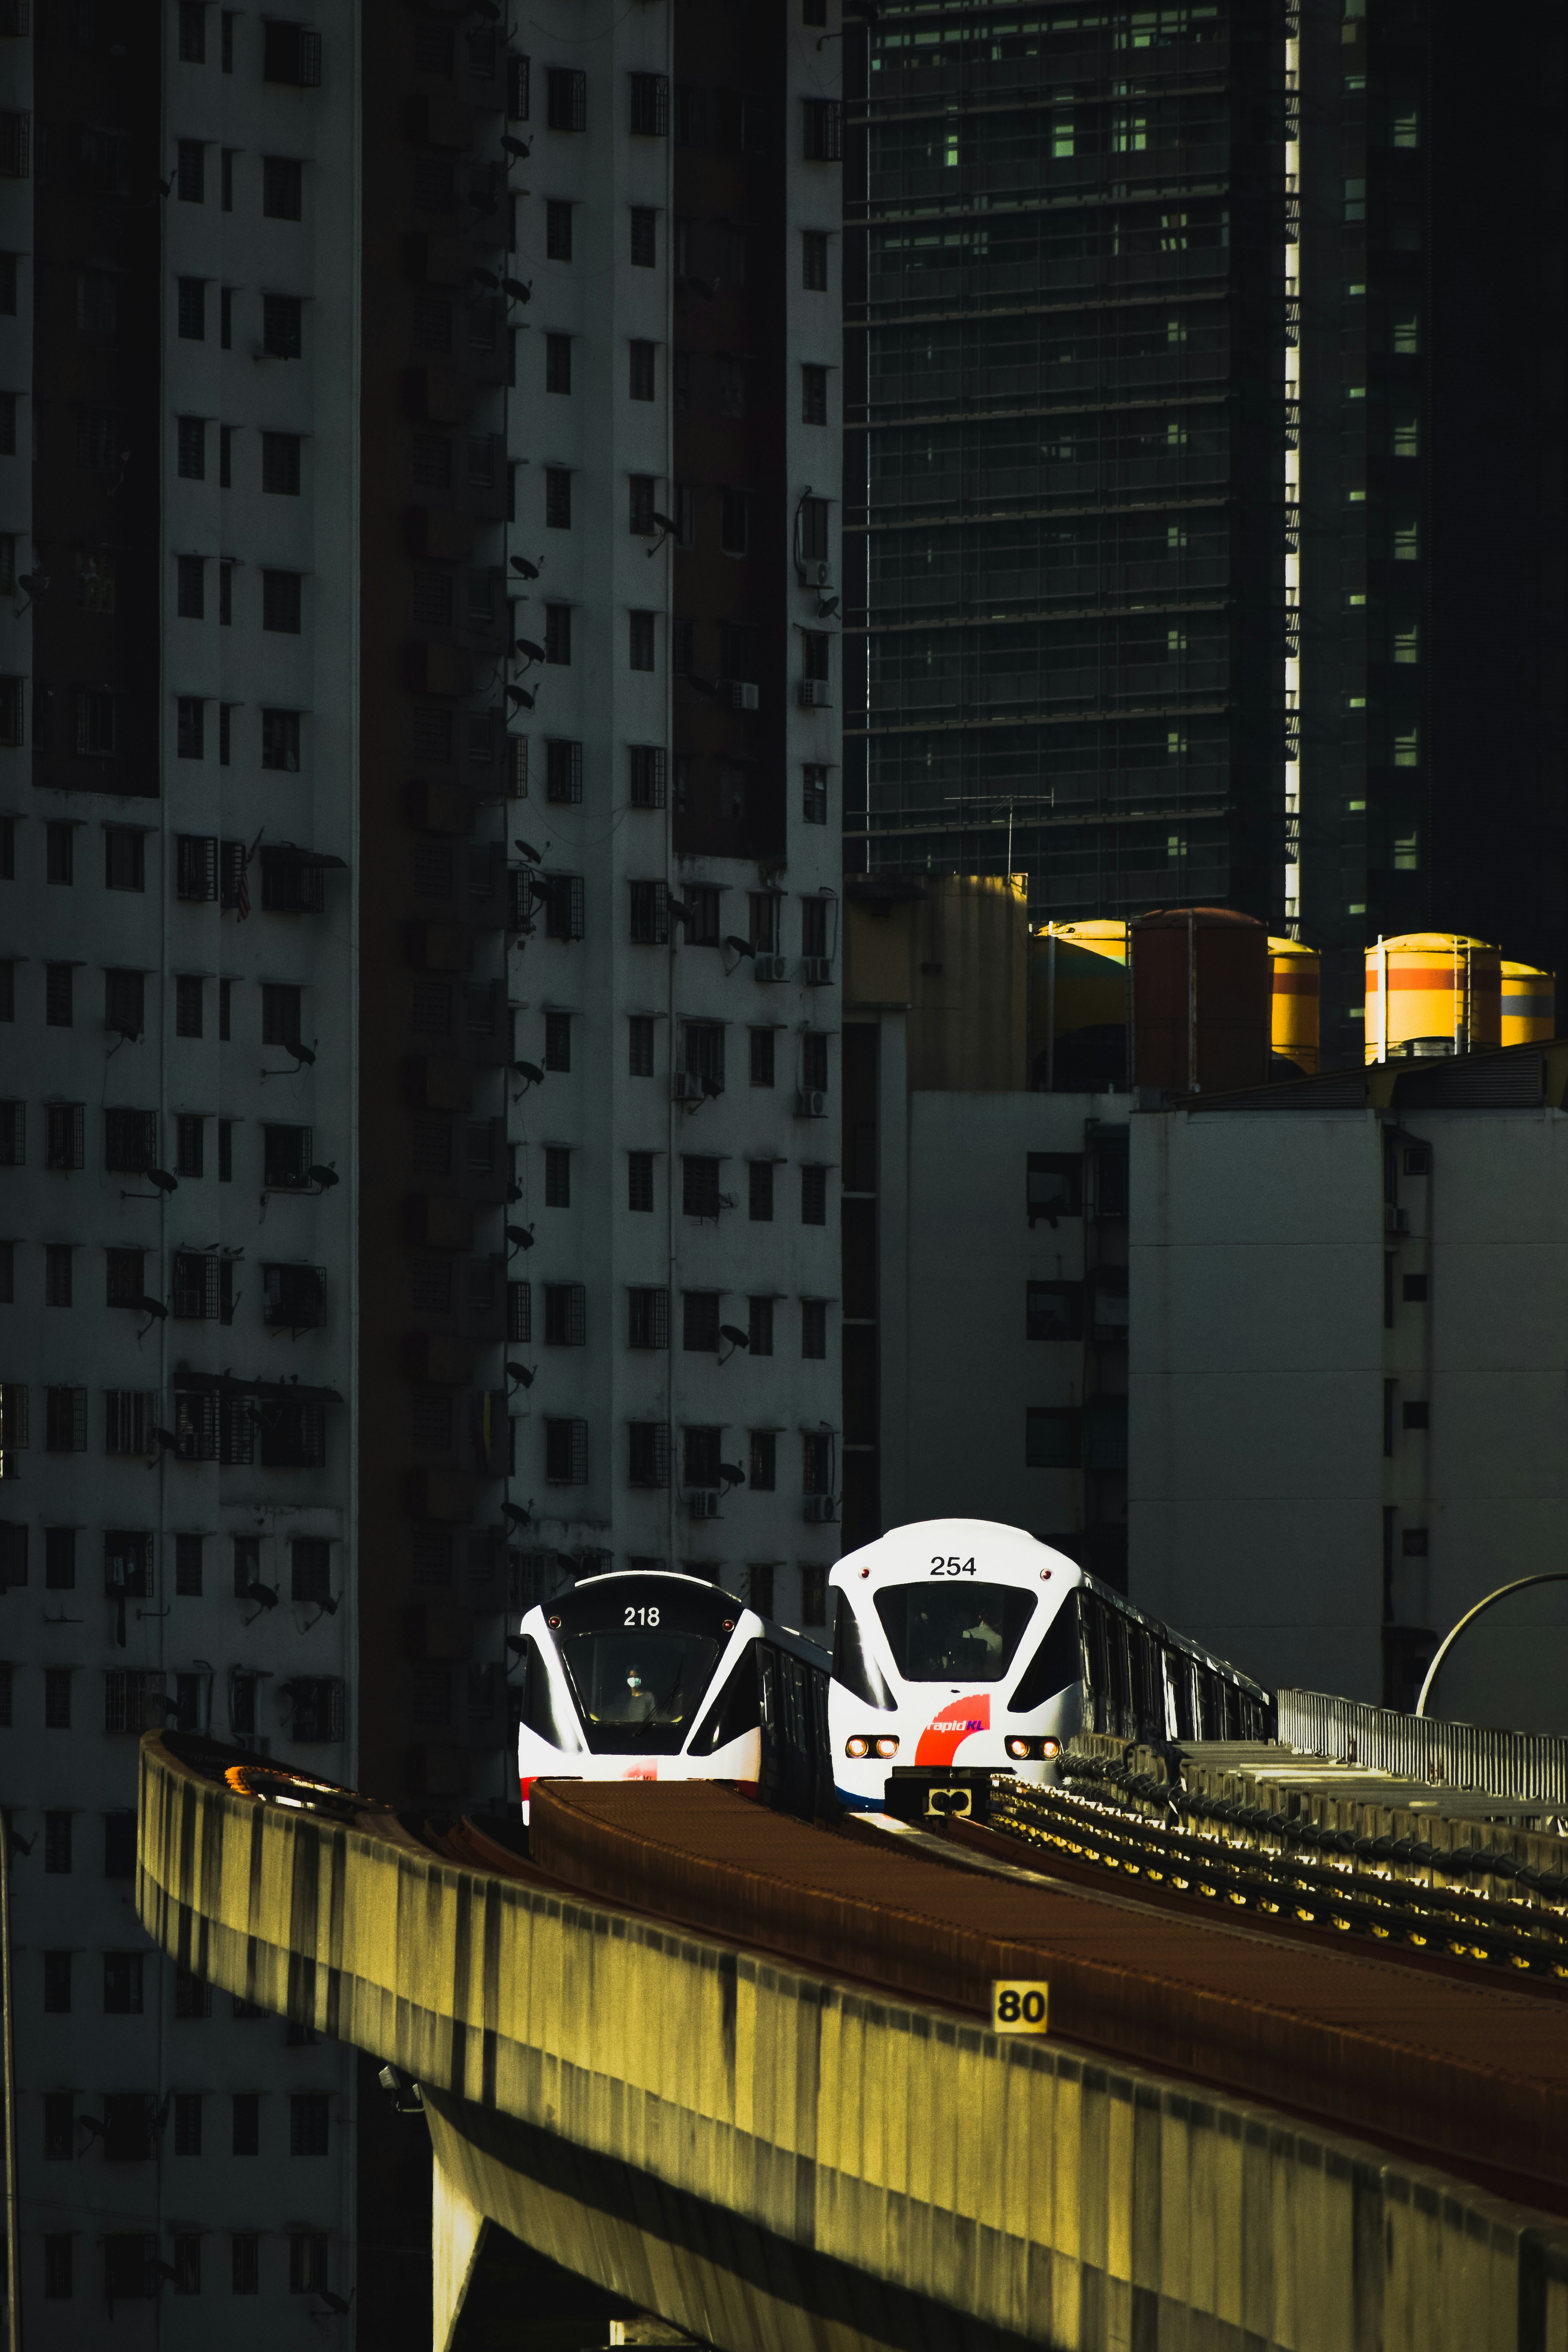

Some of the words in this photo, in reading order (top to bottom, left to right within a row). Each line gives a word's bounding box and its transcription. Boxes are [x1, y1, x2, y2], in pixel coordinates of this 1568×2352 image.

[930, 1557, 977, 1575] 254
[624, 1607, 660, 1627] 218
[926, 1720, 984, 1733] rapidKL
[998, 1990, 1045, 2023] 80
